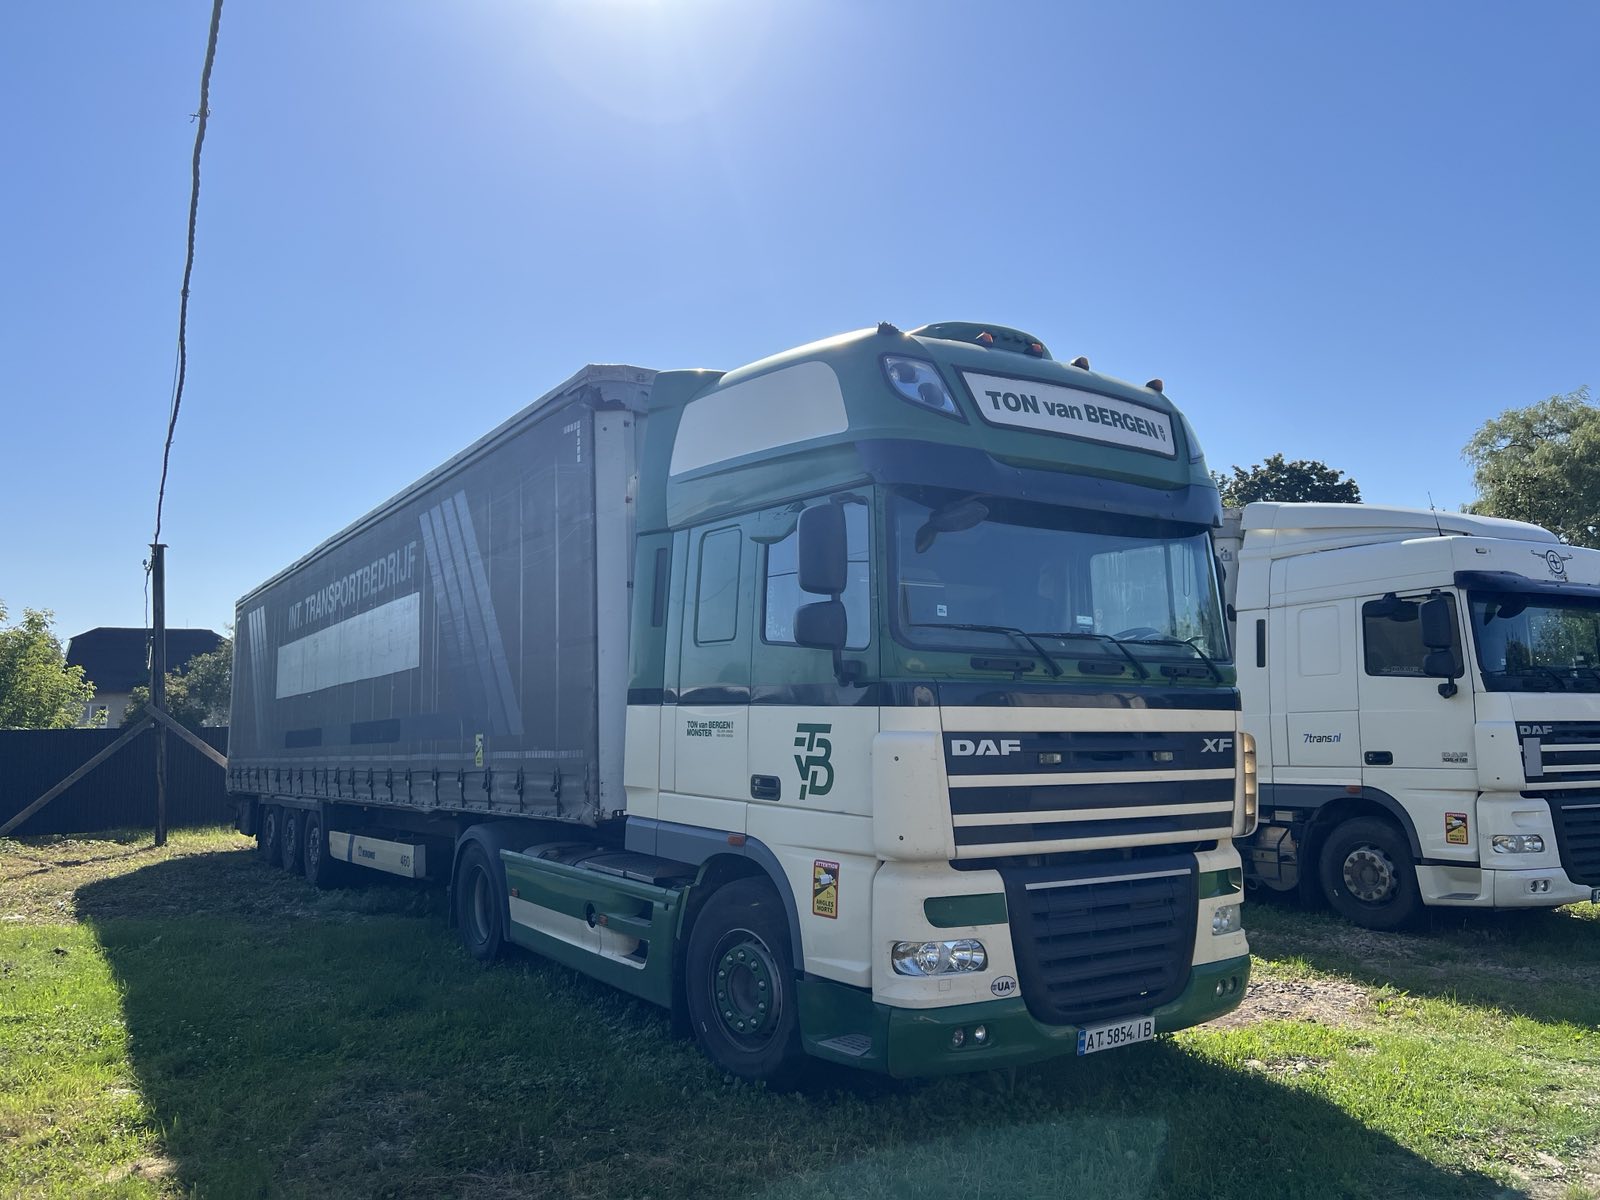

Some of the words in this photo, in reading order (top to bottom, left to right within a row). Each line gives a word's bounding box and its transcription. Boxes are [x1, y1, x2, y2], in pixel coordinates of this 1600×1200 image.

[985, 390, 1040, 414] TON
[1042, 400, 1083, 421] van
[1083, 404, 1159, 440] BERGEN
[305, 540, 417, 625] TRANSPORTBEDRIJF
[687, 720, 698, 729] TON
[708, 720, 731, 729] BERGEN
[1519, 725, 1553, 735] DAF
[686, 728, 713, 737] MONSTER
[1303, 732, 1342, 743] 7trans.nl
[951, 739, 1021, 756] DAF
[1200, 738, 1233, 753] XF
[816, 898, 834, 908] ANGLES
[816, 905, 833, 914] MORTS
[997, 980, 1010, 991] UA
[1086, 1030, 1105, 1051] AT
[1106, 1024, 1133, 1045] 5854
[1137, 1021, 1152, 1039] IB
